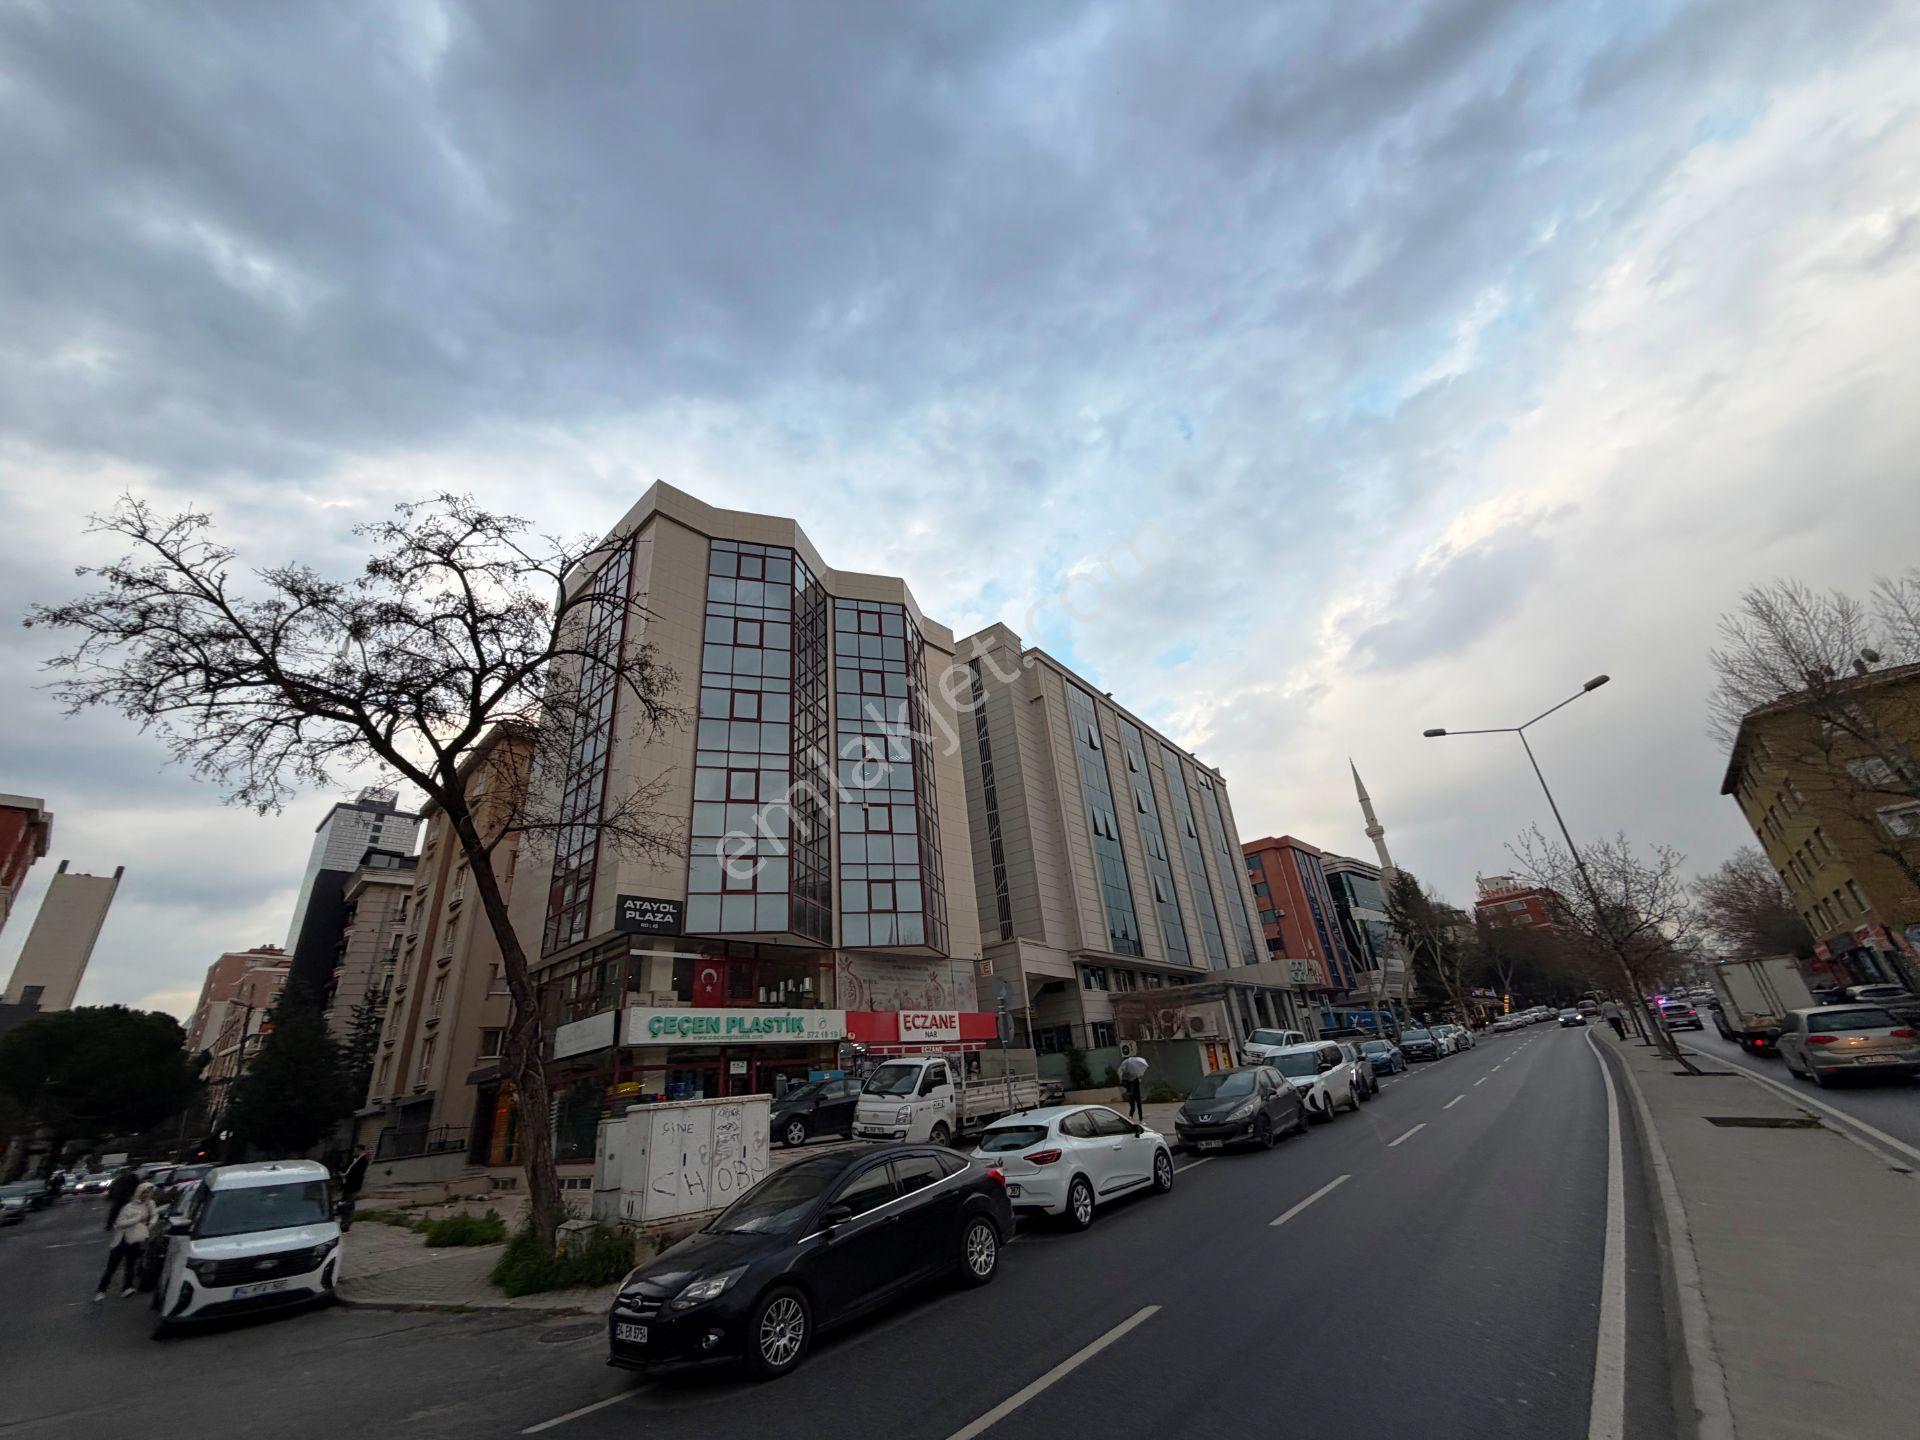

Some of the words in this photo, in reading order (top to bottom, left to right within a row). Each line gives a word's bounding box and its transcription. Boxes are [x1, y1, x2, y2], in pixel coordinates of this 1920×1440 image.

[623, 900, 677, 913] ATAYOL
[625, 910, 674, 923] PLAZA
[648, 1015, 720, 1037] ÇEÇEN
[726, 1012, 804, 1034] PLASTİK
[903, 1013, 957, 1032] ECZANE
[924, 1030, 938, 1038] NAR
